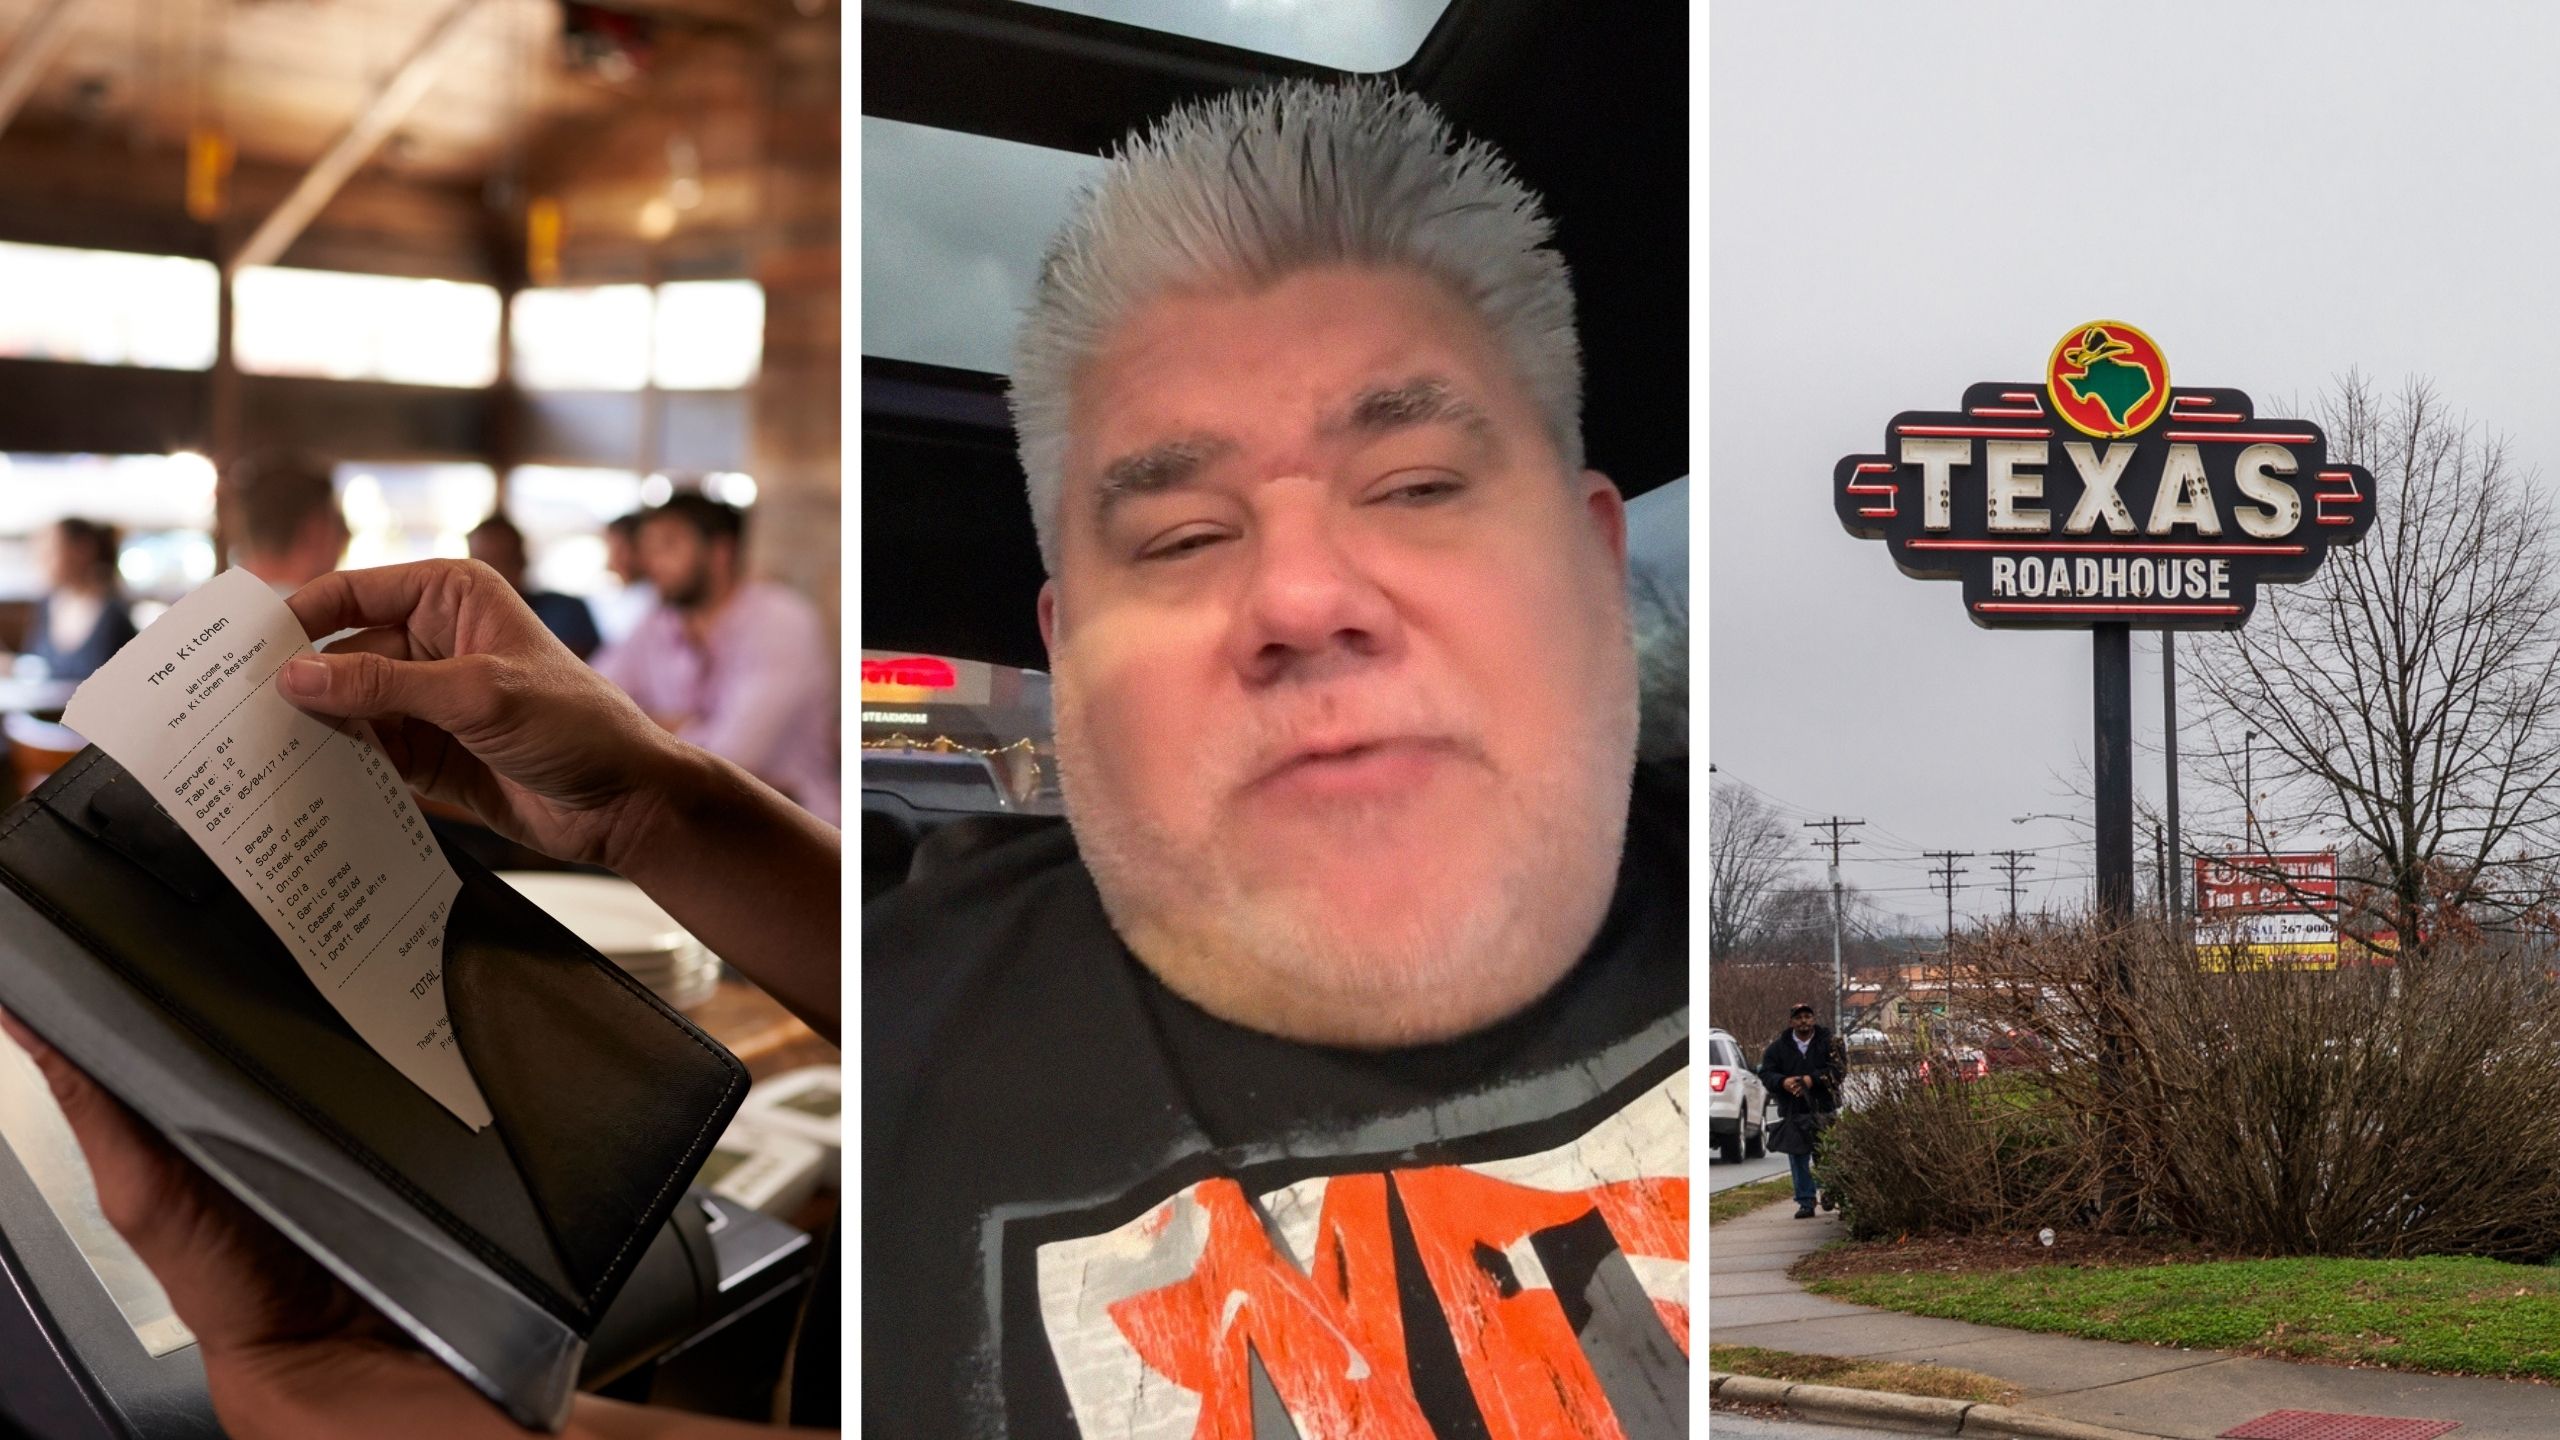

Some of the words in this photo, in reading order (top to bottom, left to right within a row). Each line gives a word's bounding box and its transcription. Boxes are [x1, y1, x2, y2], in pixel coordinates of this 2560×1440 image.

[1901, 438, 2302, 539] TEXAS
[1992, 556, 2230, 599] ROADHOUSE
[147, 662, 176, 686] The
[176, 616, 230, 661] Kitchen
[185, 662, 221, 695] Welcome
[222, 651, 234, 661] to
[167, 711, 187, 729] The
[187, 676, 225, 711] Kitchen
[223, 638, 268, 678] Restaurant
[174, 756, 213, 796] Server:
[216, 736, 234, 754] 014
[184, 773, 219, 807] Table:
[222, 757, 236, 771] 12
[196, 780, 234, 819] Guests:
[236, 768, 246, 779] 2
[206, 802, 234, 832] Date:
[237, 759, 278, 800] 05/04/17
[235, 856, 243, 865] 1
[244, 823, 274, 855] Bread
[245, 868, 254, 878] 1
[255, 842, 278, 867] Soup
[280, 828, 292, 842] of
[293, 812, 309, 828] the
[308, 796, 324, 814] Day
[256, 881, 264, 891] 1
[265, 851, 294, 880] Steak
[293, 814, 331, 851] Sandwich
[266, 895, 275, 904] 1
[275, 864, 304, 894] Onion
[303, 839, 328, 865] Rings
[277, 908, 285, 917] 1
[286, 883, 310, 907] Cola
[287, 921, 296, 930] 1
[296, 887, 328, 920] Garlic
[327, 861, 352, 888] Bread
[298, 935, 306, 944] 1
[307, 901, 336, 934] Ceaser
[337, 875, 361, 902] Salad
[309, 948, 317, 957] 1
[317, 920, 344, 948] Large
[343, 895, 367, 921] House
[366, 873, 387, 896] White
[320, 961, 328, 970] 1
[328, 933, 353, 961] Draft
[353, 913, 371, 934] Beer
[409, 963, 443, 1000] TOTAL:
[416, 1028, 438, 1051] Thank
[439, 1031, 458, 1051] Plea
